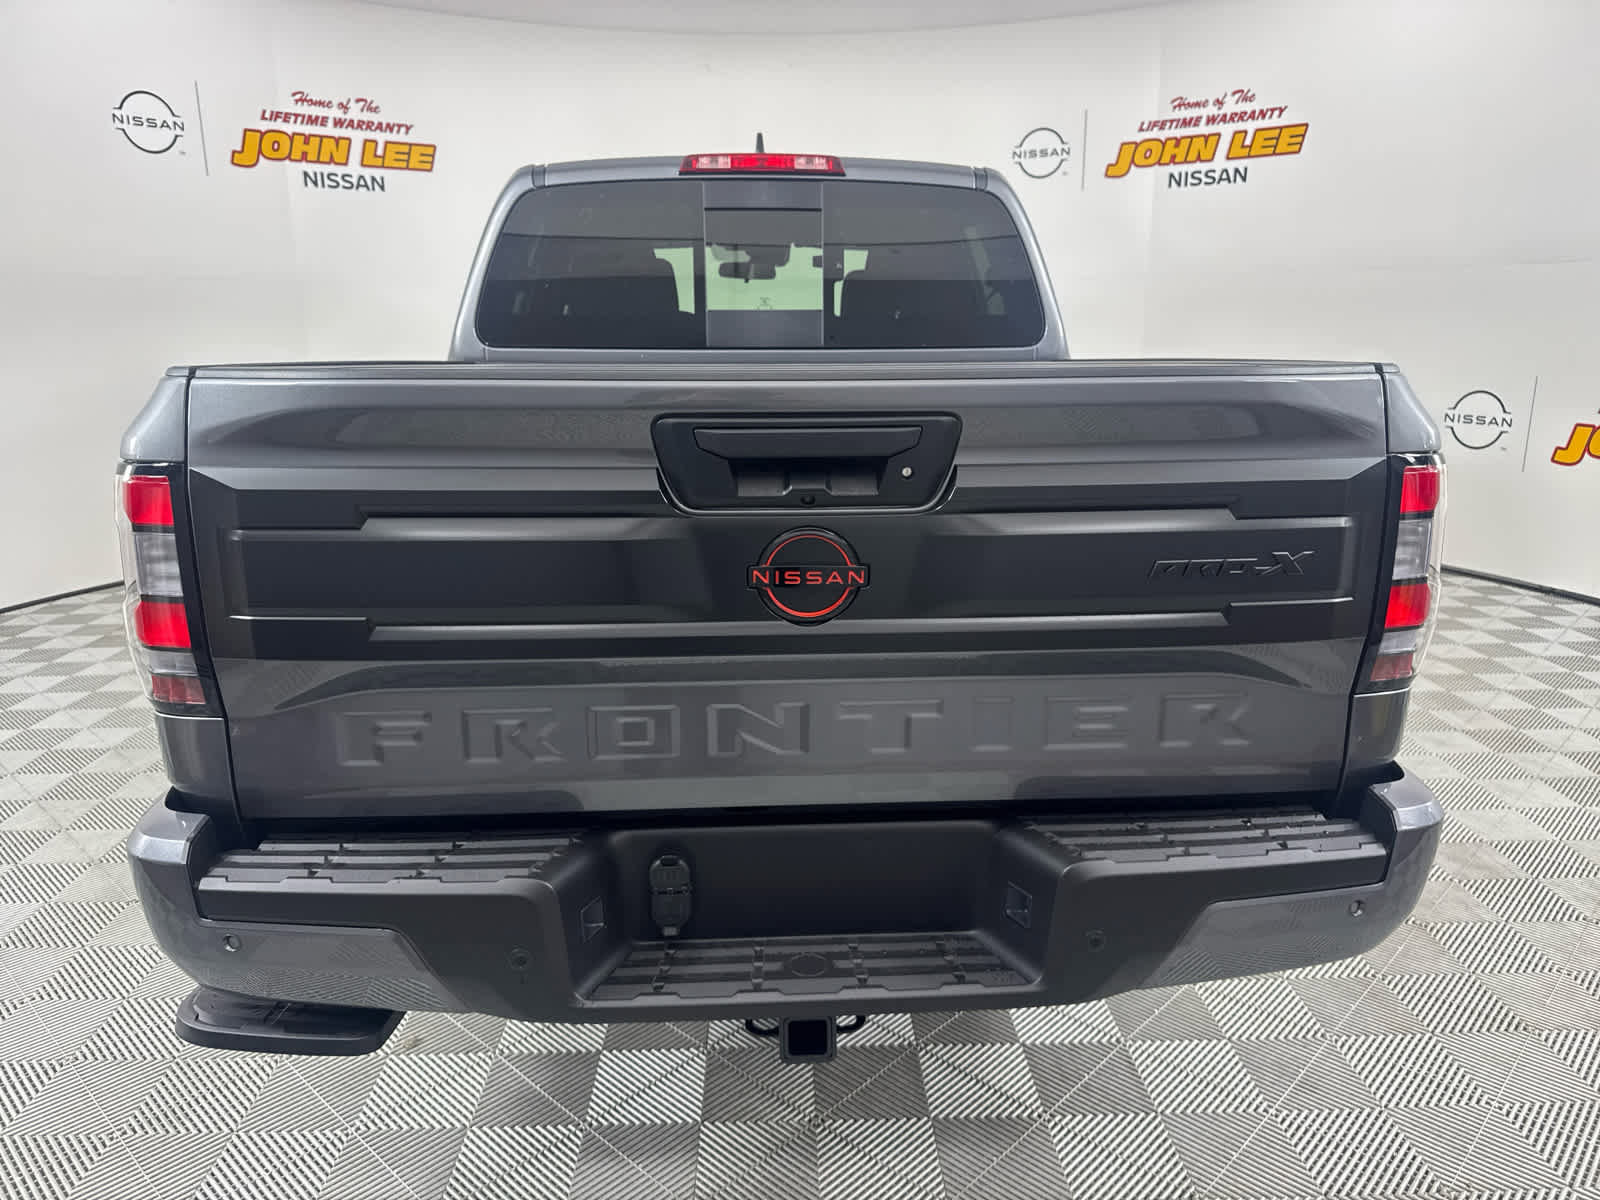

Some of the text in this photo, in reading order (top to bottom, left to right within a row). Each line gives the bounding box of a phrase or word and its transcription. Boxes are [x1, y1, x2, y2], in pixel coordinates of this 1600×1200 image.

[291, 91, 381, 114] Home of The
[1170, 88, 1256, 112] Home of The
[112, 112, 185, 132] NISSAN
[260, 109, 414, 135] LIFETIME WARRANTY
[1137, 105, 1288, 133] LIFETIME WARRANTY
[231, 128, 437, 172] JOHN LEE
[1012, 146, 1071, 160] NISSAN
[1104, 122, 1309, 178] JOHN LEE
[303, 170, 386, 193] NISSAN
[1168, 166, 1248, 189] NISSAN
[1444, 412, 1513, 428] NISSAN
[752, 569, 865, 585] NISSAN
[336, 692, 1252, 768] FRONTIER
